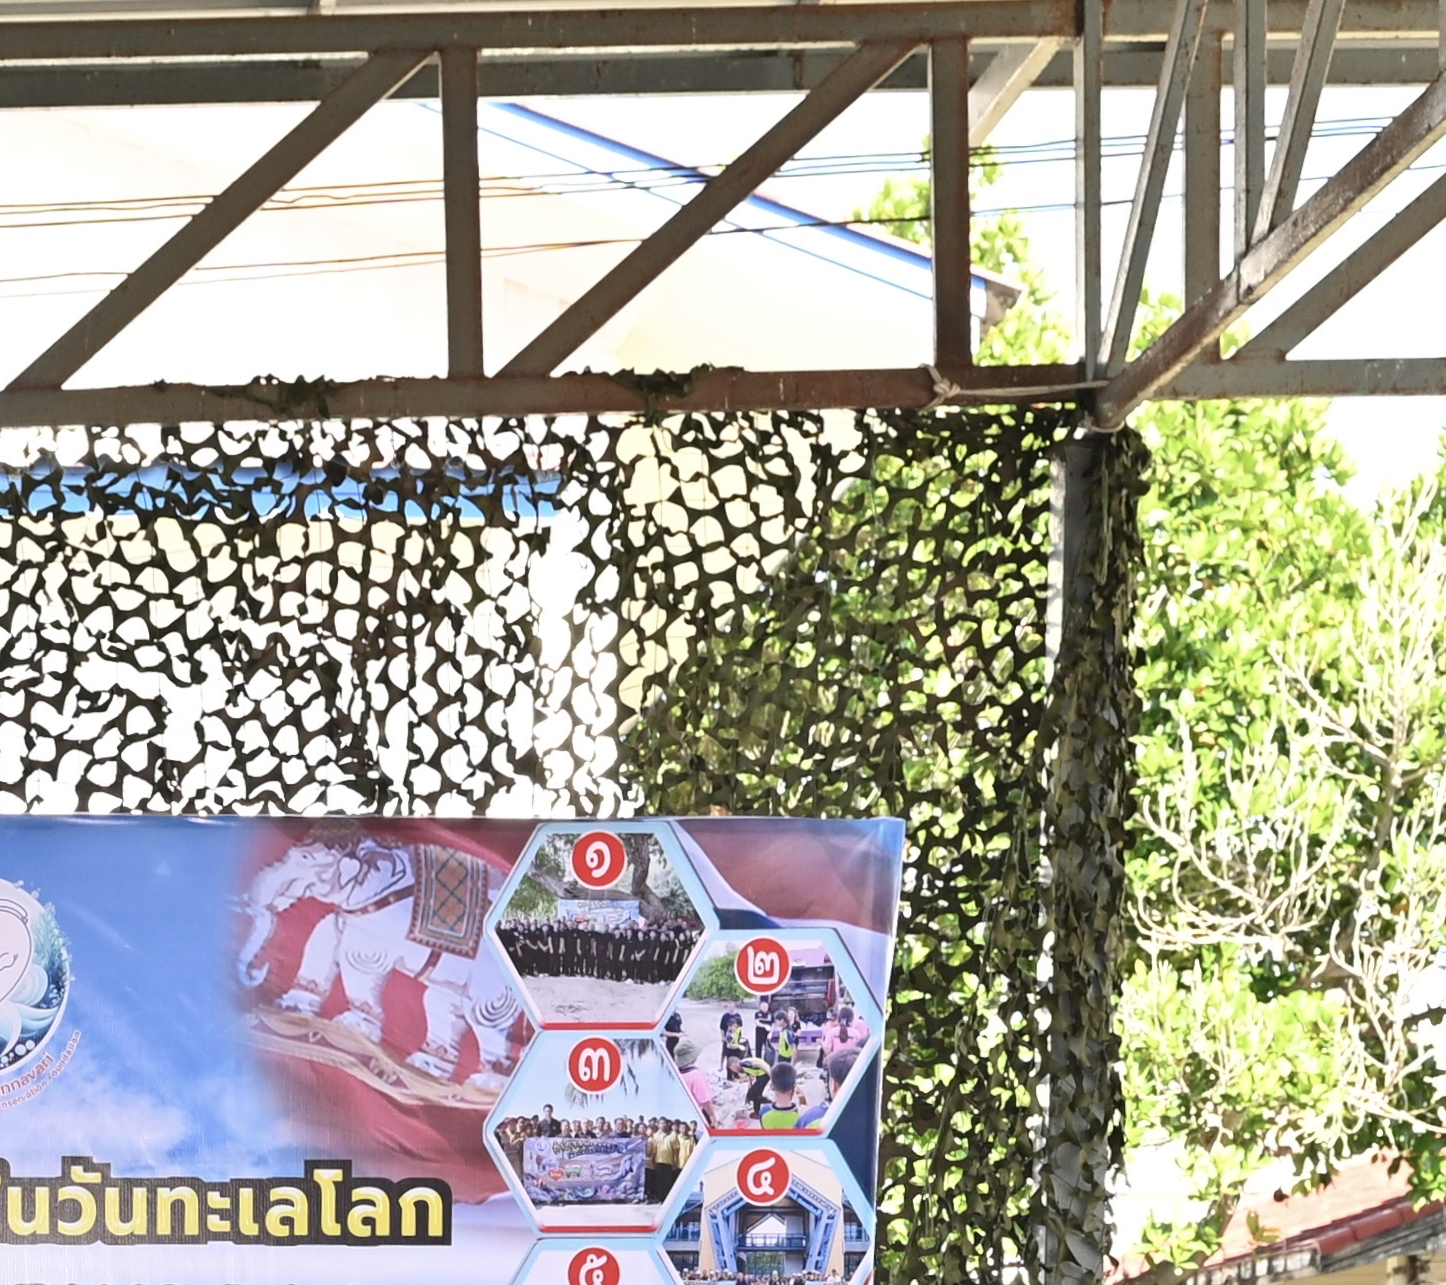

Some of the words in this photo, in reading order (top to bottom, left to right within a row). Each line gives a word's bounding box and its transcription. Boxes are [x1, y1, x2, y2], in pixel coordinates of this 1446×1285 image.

[585, 844, 612, 877] ๑
[746, 948, 780, 983] ๒
[578, 1049, 610, 1079] ๓
[745, 1157, 777, 1194] ๔
